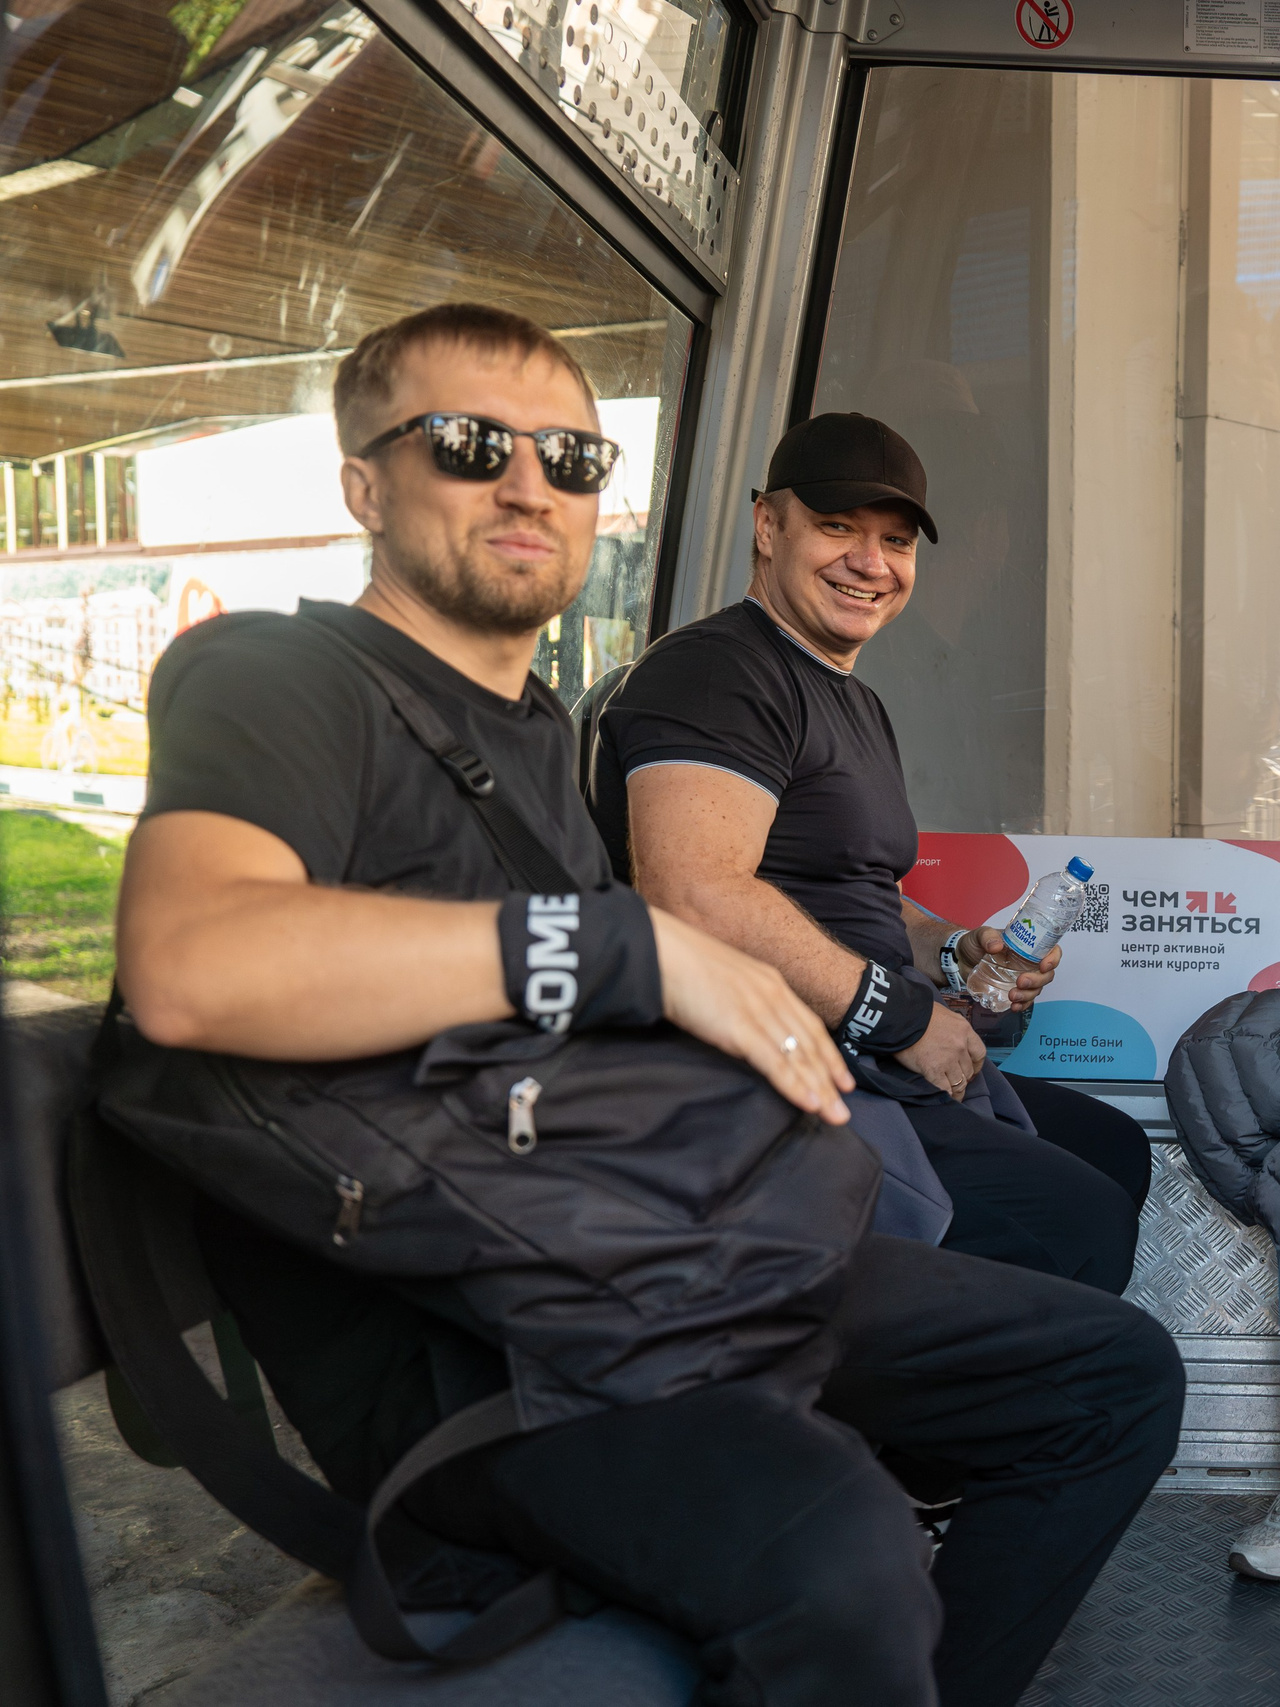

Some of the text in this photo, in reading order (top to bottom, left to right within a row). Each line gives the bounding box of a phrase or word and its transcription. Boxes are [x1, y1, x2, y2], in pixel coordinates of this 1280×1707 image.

[1122, 890, 1179, 908] чем
[1014, 920, 1037, 942] ГОРНАЯ
[1121, 914, 1261, 935] заняться
[1009, 923, 1035, 948] ВЕРШИНА
[1121, 942, 1225, 956] центр активной
[1121, 959, 1220, 972] жизни курорта
[843, 959, 891, 1056] МЕТР
[1039, 1035, 1123, 1049] Горные бани
[1039, 1051, 1115, 1063] «4 стихии»
